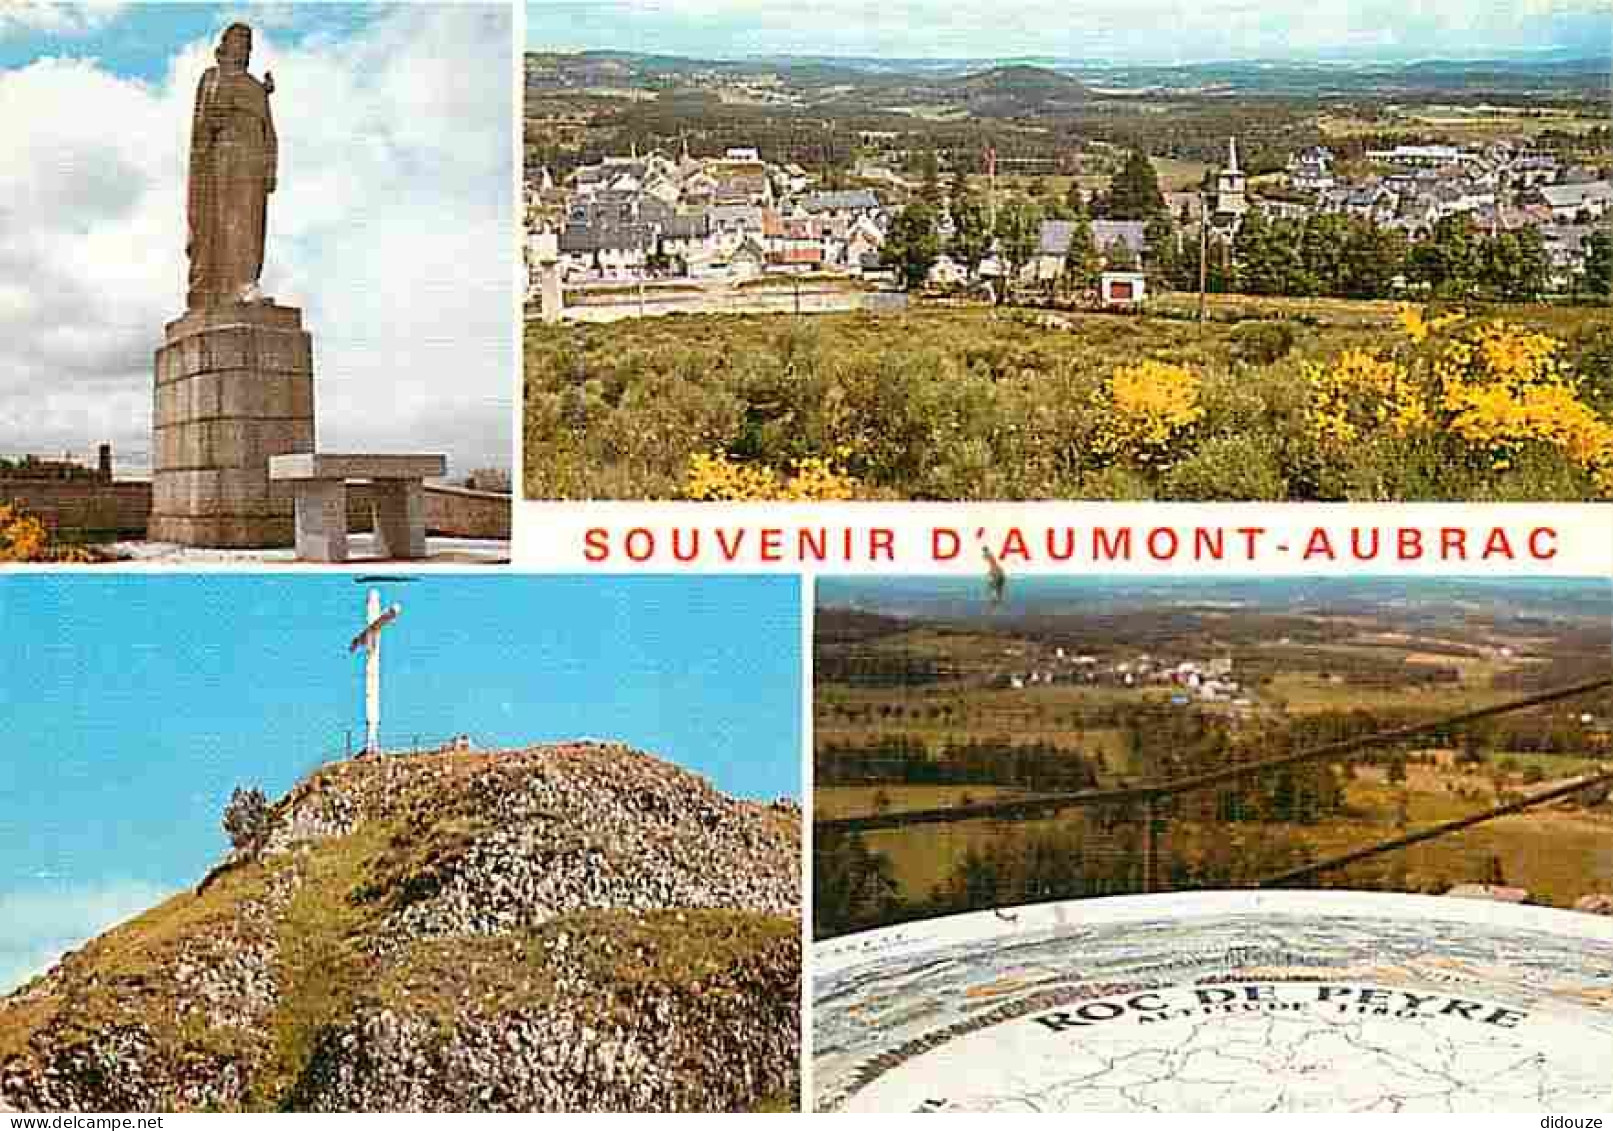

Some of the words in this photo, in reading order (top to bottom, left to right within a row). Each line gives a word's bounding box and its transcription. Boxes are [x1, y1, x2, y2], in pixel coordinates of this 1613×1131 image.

[583, 525, 896, 562] SOUVENIR
[930, 525, 1559, 562] D'AUMONT-AUBRAC
[1033, 994, 1168, 1031] ROC
[1195, 985, 1274, 1004] DE
[1319, 984, 1527, 1028] PEYRE
